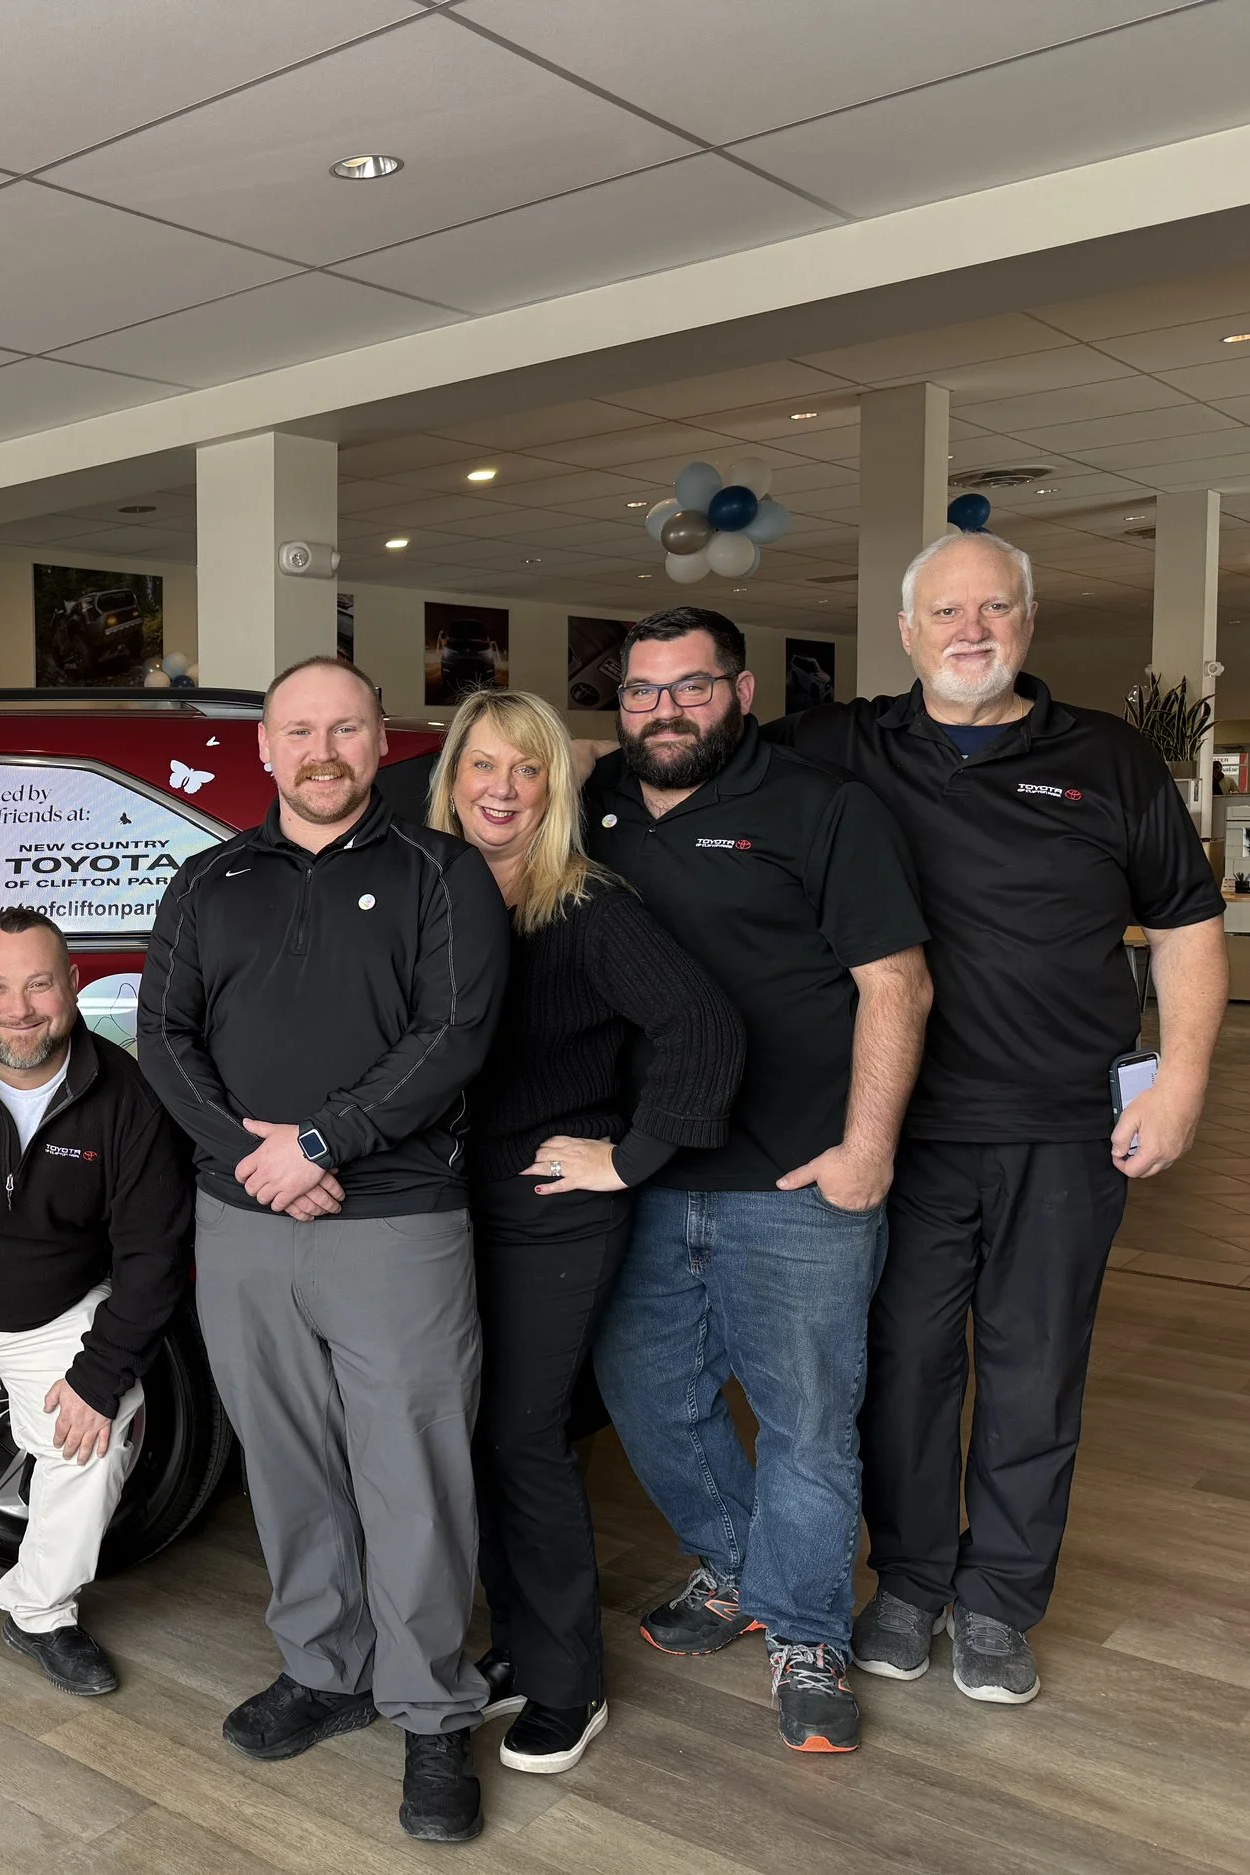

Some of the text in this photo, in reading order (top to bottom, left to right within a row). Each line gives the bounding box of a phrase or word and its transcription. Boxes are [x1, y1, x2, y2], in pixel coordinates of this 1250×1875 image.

[28, 784, 52, 804] by
[1018, 783, 1062, 795] TOYOTA
[66, 807, 91, 822] at:
[19, 840, 170, 852] NEW COUNTRY
[5, 853, 180, 874] TOYOTA
[4, 876, 173, 889] OF CLIFTON PAR
[46, 1143, 81, 1155] TOYOTA
